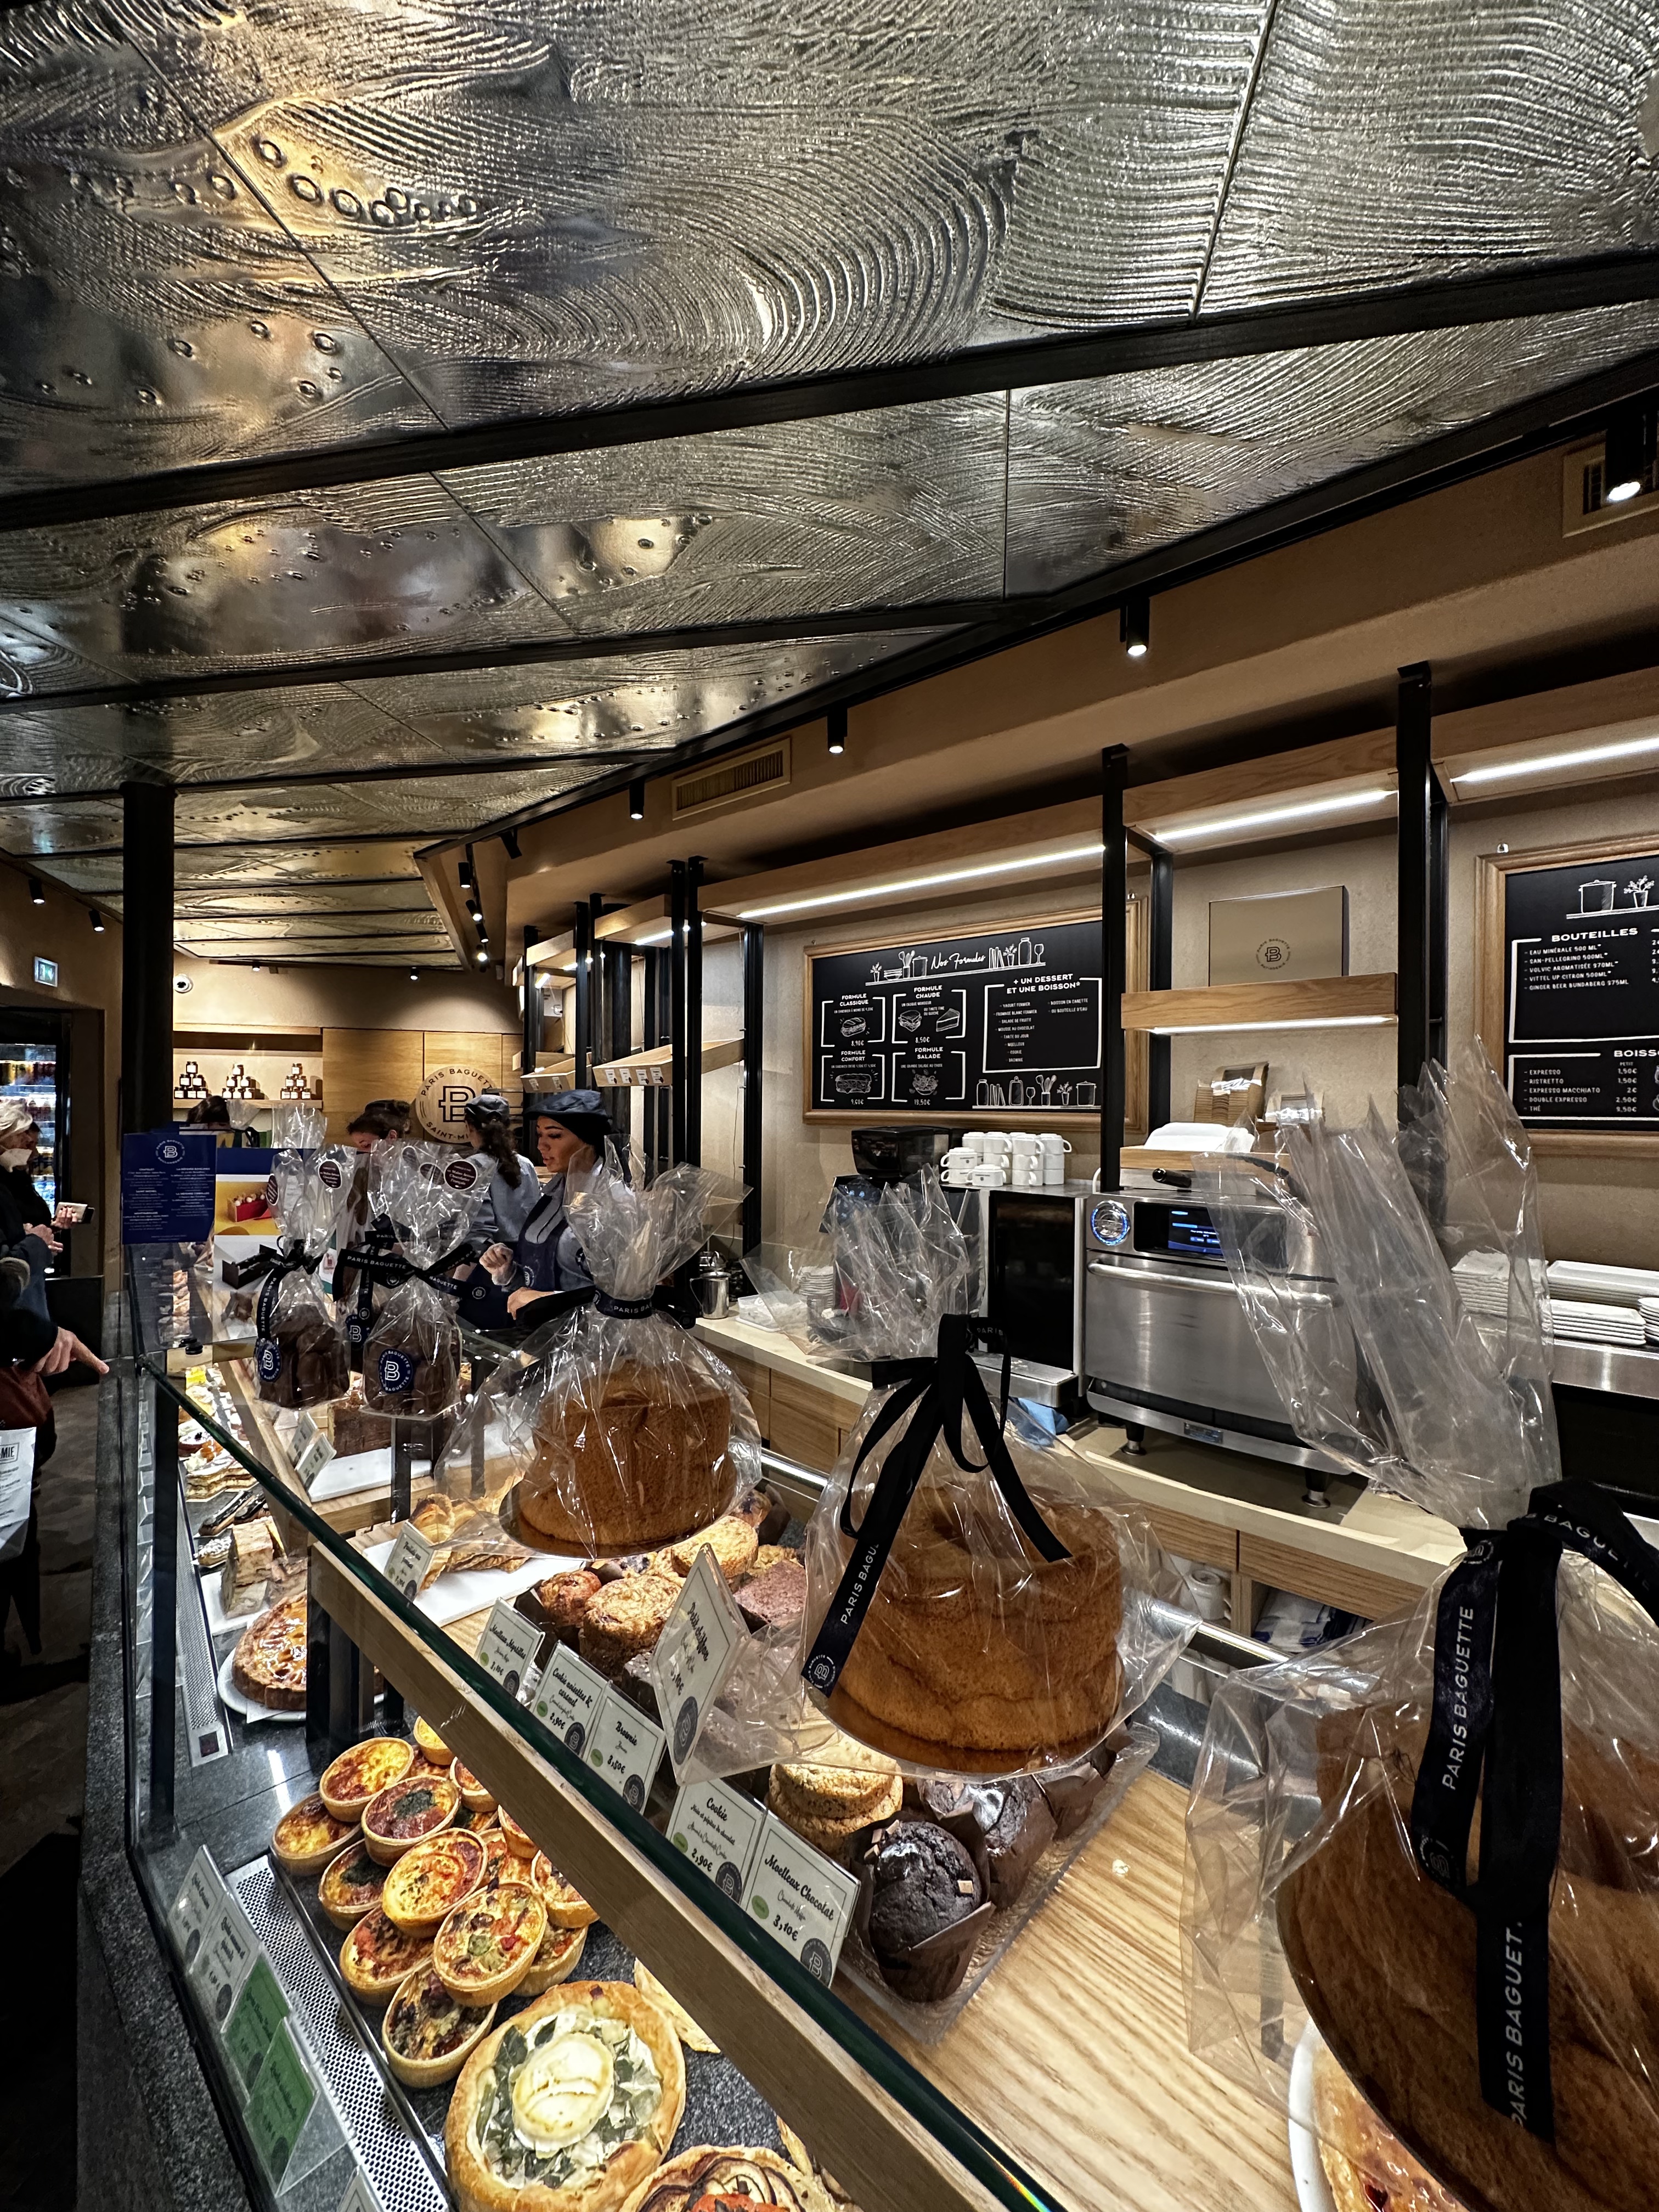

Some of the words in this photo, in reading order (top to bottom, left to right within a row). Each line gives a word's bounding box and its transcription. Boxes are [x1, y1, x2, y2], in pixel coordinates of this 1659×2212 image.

[1551, 927, 1639, 943] BOUTEILLES
[1529, 955, 1582, 964] SAN-PELLEGRINO
[1542, 946, 1573, 955] MINÉRALE
[930, 952, 949, 969] Nos
[949, 952, 986, 970] Formules
[1552, 962, 1592, 972] AROMATISÉE
[1035, 973, 1074, 984] DESSERT
[1561, 972, 1585, 980] CITRON
[1568, 980, 1606, 989] BUNDABERG
[913, 985, 943, 993] FORMULE
[421, 1071, 445, 1096] PARIS
[449, 1068, 494, 1091] BAGUETT
[426, 1121, 469, 1140] SAINT-MI
[347, 1255, 368, 1264] PARIS
[370, 1260, 407, 1269] BAGUETTE
[429, 1276, 458, 1290] BAGUETTE
[613, 1305, 639, 1313] PARIS
[840, 1583, 862, 1624] PARIS
[1453, 1605, 1475, 1720] BAGUETTE
[552, 1667, 569, 1688] Cookie
[567, 1681, 586, 1701] noisettes
[557, 1688, 577, 1707] caramel
[549, 1712, 566, 1730] 2,90€
[615, 1720, 638, 1747] Brownie
[607, 1754, 626, 1774] 3,50€
[1442, 1724, 1469, 1792] PARIS
[706, 1797, 728, 1821] Cookie
[691, 1847, 713, 1872] 2,90€
[765, 1854, 800, 1892] Moelleux
[800, 1884, 834, 1921] Chocolat
[772, 1915, 799, 1941] 3,10€
[1505, 1921, 1524, 2046] BAGUET
[1506, 2050, 1528, 2128] PARIS
